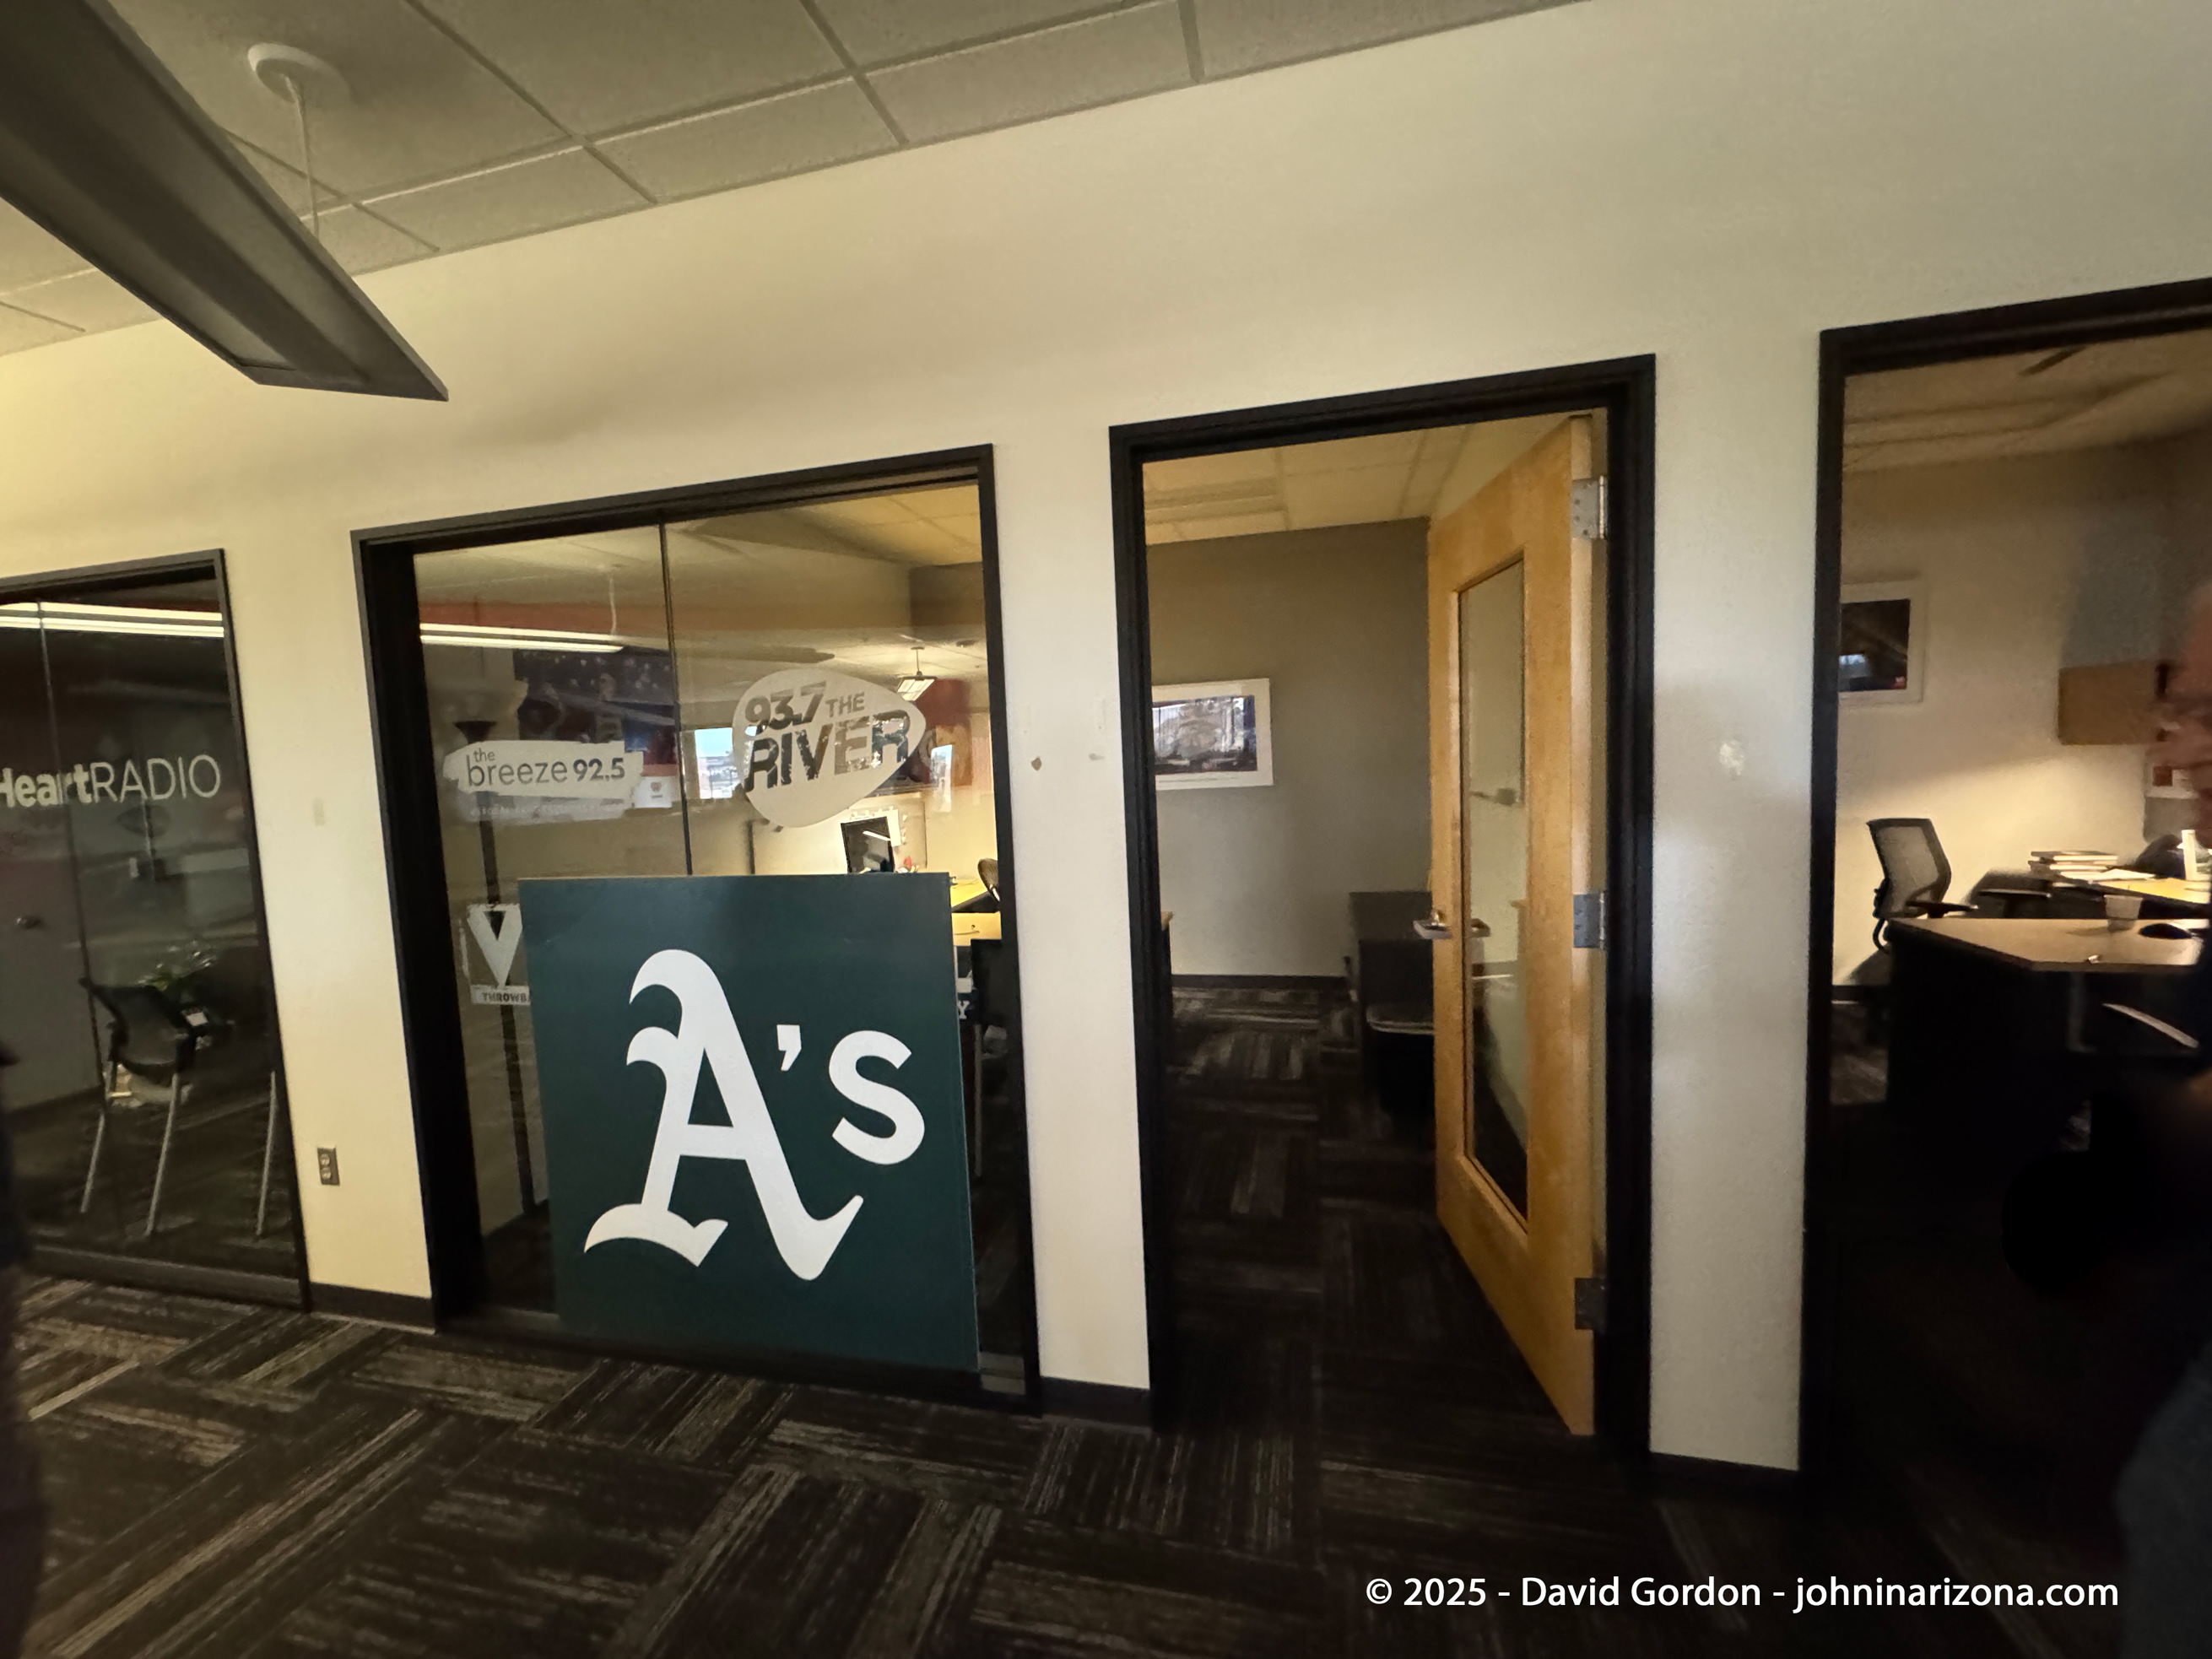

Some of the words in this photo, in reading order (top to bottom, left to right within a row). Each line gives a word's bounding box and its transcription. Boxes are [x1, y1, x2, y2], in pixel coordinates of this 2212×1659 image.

[745, 681, 826, 735] 93.7
[825, 692, 866, 718] THE
[466, 755, 568, 786] breeze
[573, 758, 625, 781] 92.5
[473, 748, 495, 763] the
[744, 710, 911, 792] RIVER
[482, 992, 529, 1002] THROWB
[584, 949, 925, 1281] A's
